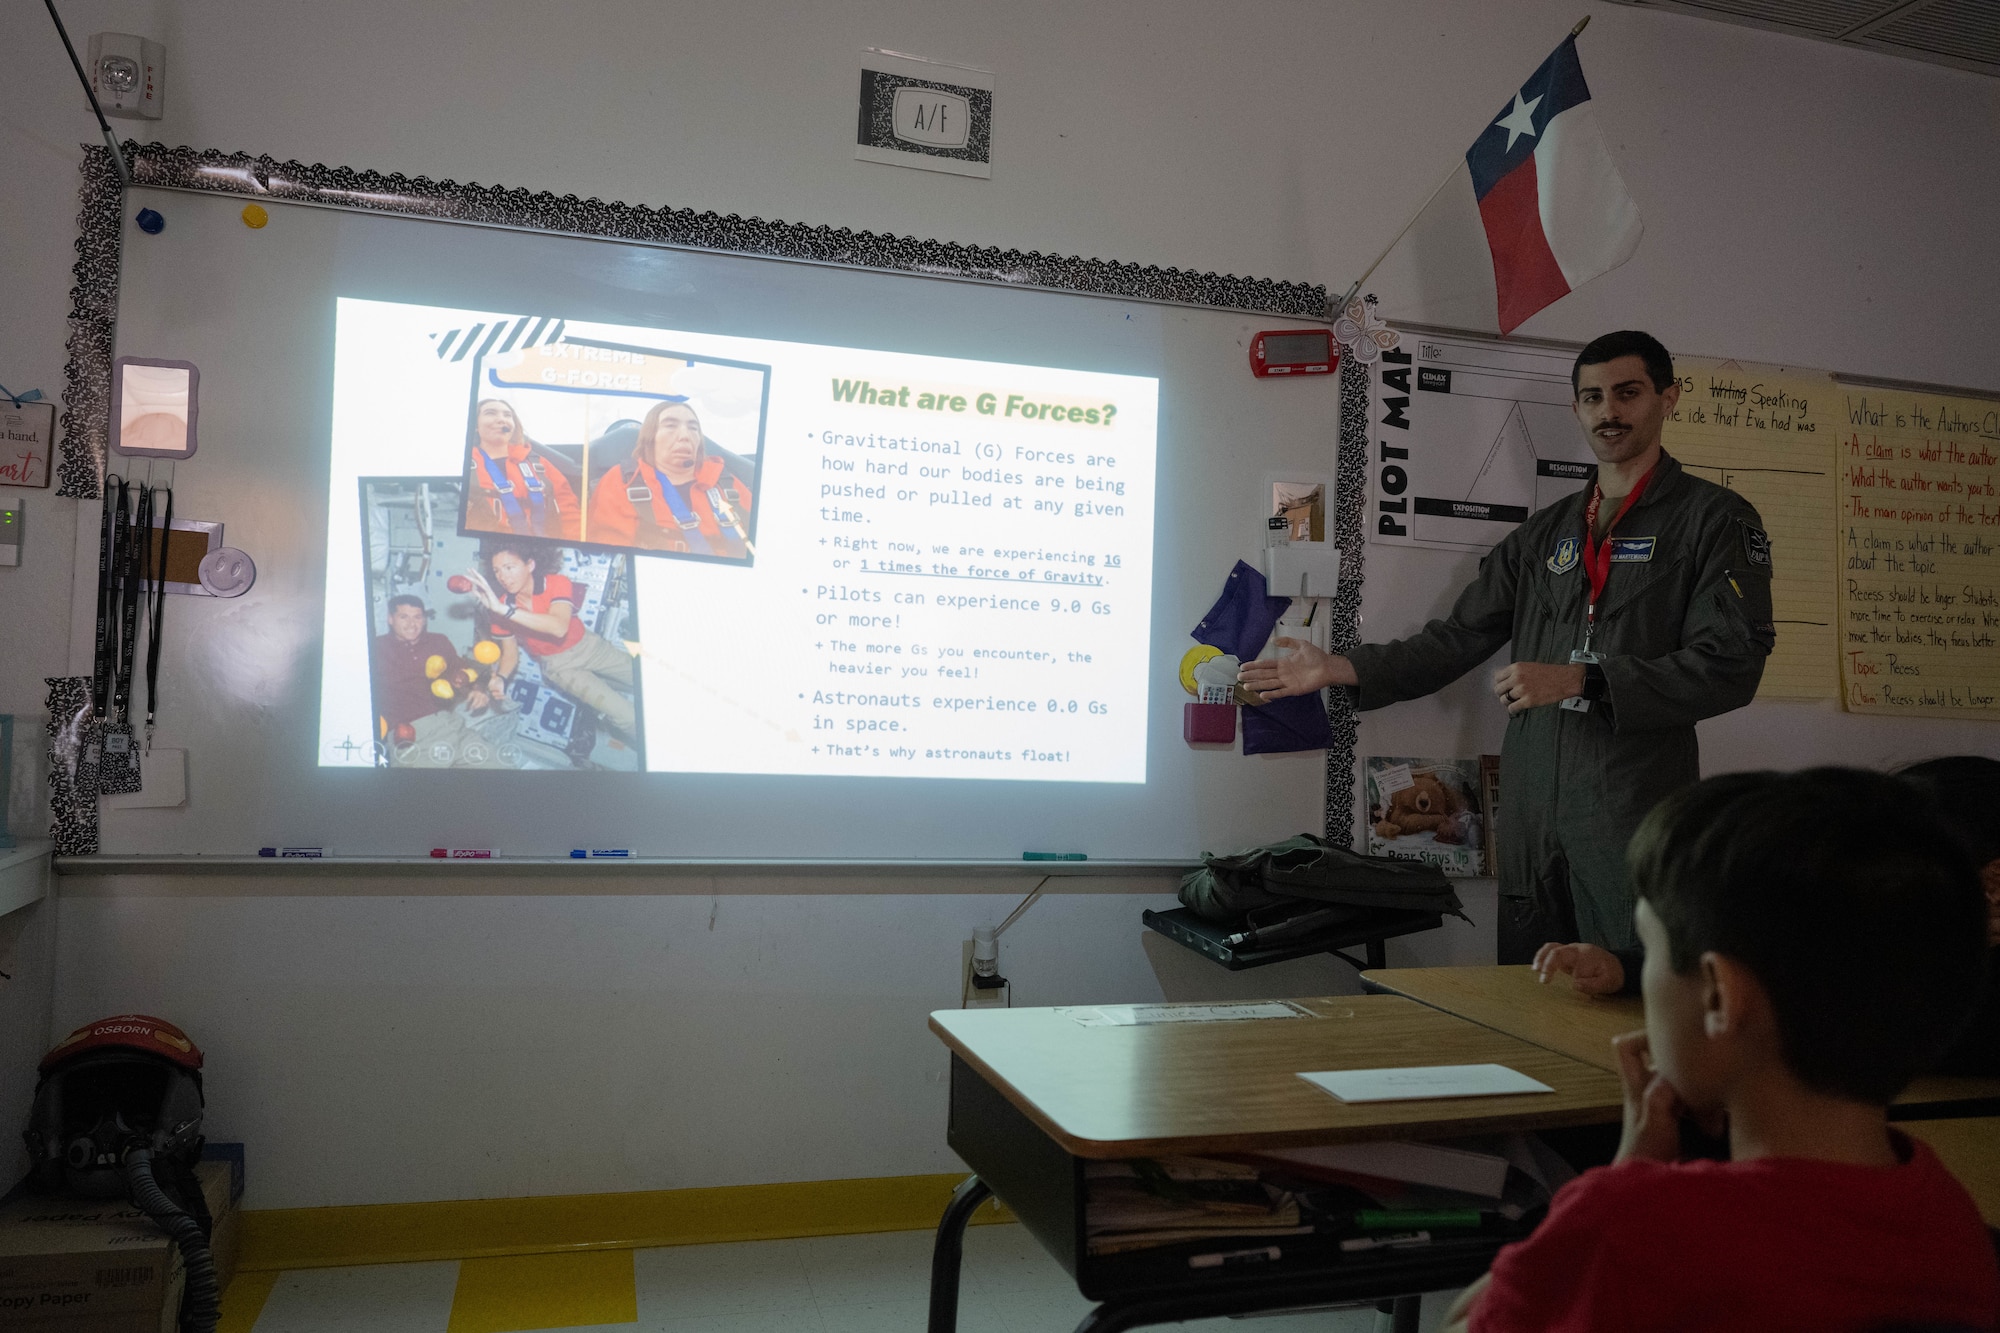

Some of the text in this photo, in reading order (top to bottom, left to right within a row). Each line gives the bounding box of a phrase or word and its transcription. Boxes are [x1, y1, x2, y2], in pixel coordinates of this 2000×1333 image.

[914, 103, 948, 133] A/F
[540, 345, 646, 366] EXTREME
[1422, 344, 1442, 359] Title:
[541, 367, 643, 390] G-FORCE
[1422, 372, 1447, 382] CLIMAX
[831, 378, 1118, 427] What are G Forces?
[1751, 384, 1808, 418] Speaking
[1847, 395, 1888, 426] What
[1896, 411, 1906, 427] is
[1911, 403, 1930, 430] the
[1713, 404, 1739, 426] that
[1746, 409, 1766, 429] Eva
[1772, 411, 1791, 431] had
[1798, 422, 1815, 432] was
[8, 430, 39, 443] hand,
[822, 430, 1116, 468] Gravitational (G) Forces are
[1851, 433, 1997, 465] A claim is what the author
[822, 455, 1126, 496] how hard our bodies are being
[1549, 463, 1588, 473] RESOLUTION
[1378, 440, 1409, 537] PLOT
[1851, 465, 1994, 501] What the author wants you to
[820, 482, 1125, 518] pushed or pulled at any given
[1452, 503, 1491, 514] EXPOSITION
[1851, 496, 1869, 518] The
[1901, 508, 1933, 524] opinion
[1939, 505, 1951, 522] of
[1956, 504, 1975, 524] the
[819, 507, 872, 525] time.
[833, 536, 1121, 569] Right now, we are experiencing 1G
[1848, 527, 1995, 556] A claim is what the author
[833, 557, 851, 569] or
[860, 559, 869, 572] 1
[878, 561, 923, 575] times
[932, 562, 958, 577] the
[967, 565, 1010, 579] force
[1018, 569, 1036, 581] of
[1848, 551, 1876, 570] about
[1884, 553, 1904, 572] the
[817, 585, 1112, 616] Pilots can experience 9.0 Gs
[1847, 579, 1884, 601] Recess
[1889, 585, 1915, 602] should
[1921, 585, 1930, 604] be
[816, 613, 901, 629] or more!
[1851, 611, 1870, 621] more
[1872, 605, 1891, 621] time
[1894, 606, 1905, 621] to
[1911, 613, 1944, 624] exercise
[1946, 614, 1956, 624] or
[1849, 632, 1868, 643] move
[1870, 625, 1891, 643] their
[1927, 627, 1947, 651] they
[1973, 631, 1996, 647] better
[830, 641, 1092, 664] The more Gs you encounter, the
[1886, 653, 1920, 675] Recess
[829, 662, 979, 679] heavier you feel!
[812, 691, 1109, 715] Astronauts experience 0.0 Gs
[1882, 685, 1915, 705] Recess
[1919, 689, 1945, 707] should
[1950, 688, 1963, 706] be
[1968, 687, 1995, 708] longer
[812, 716, 908, 735] in space.
[889, 746, 917, 761] why
[925, 747, 1012, 762] astronauts
[1021, 750, 1071, 763] float!
[1419, 850, 1451, 866] Stays
[94, 1024, 152, 1037] OSBORN
[40, 1292, 92, 1307] Paper
